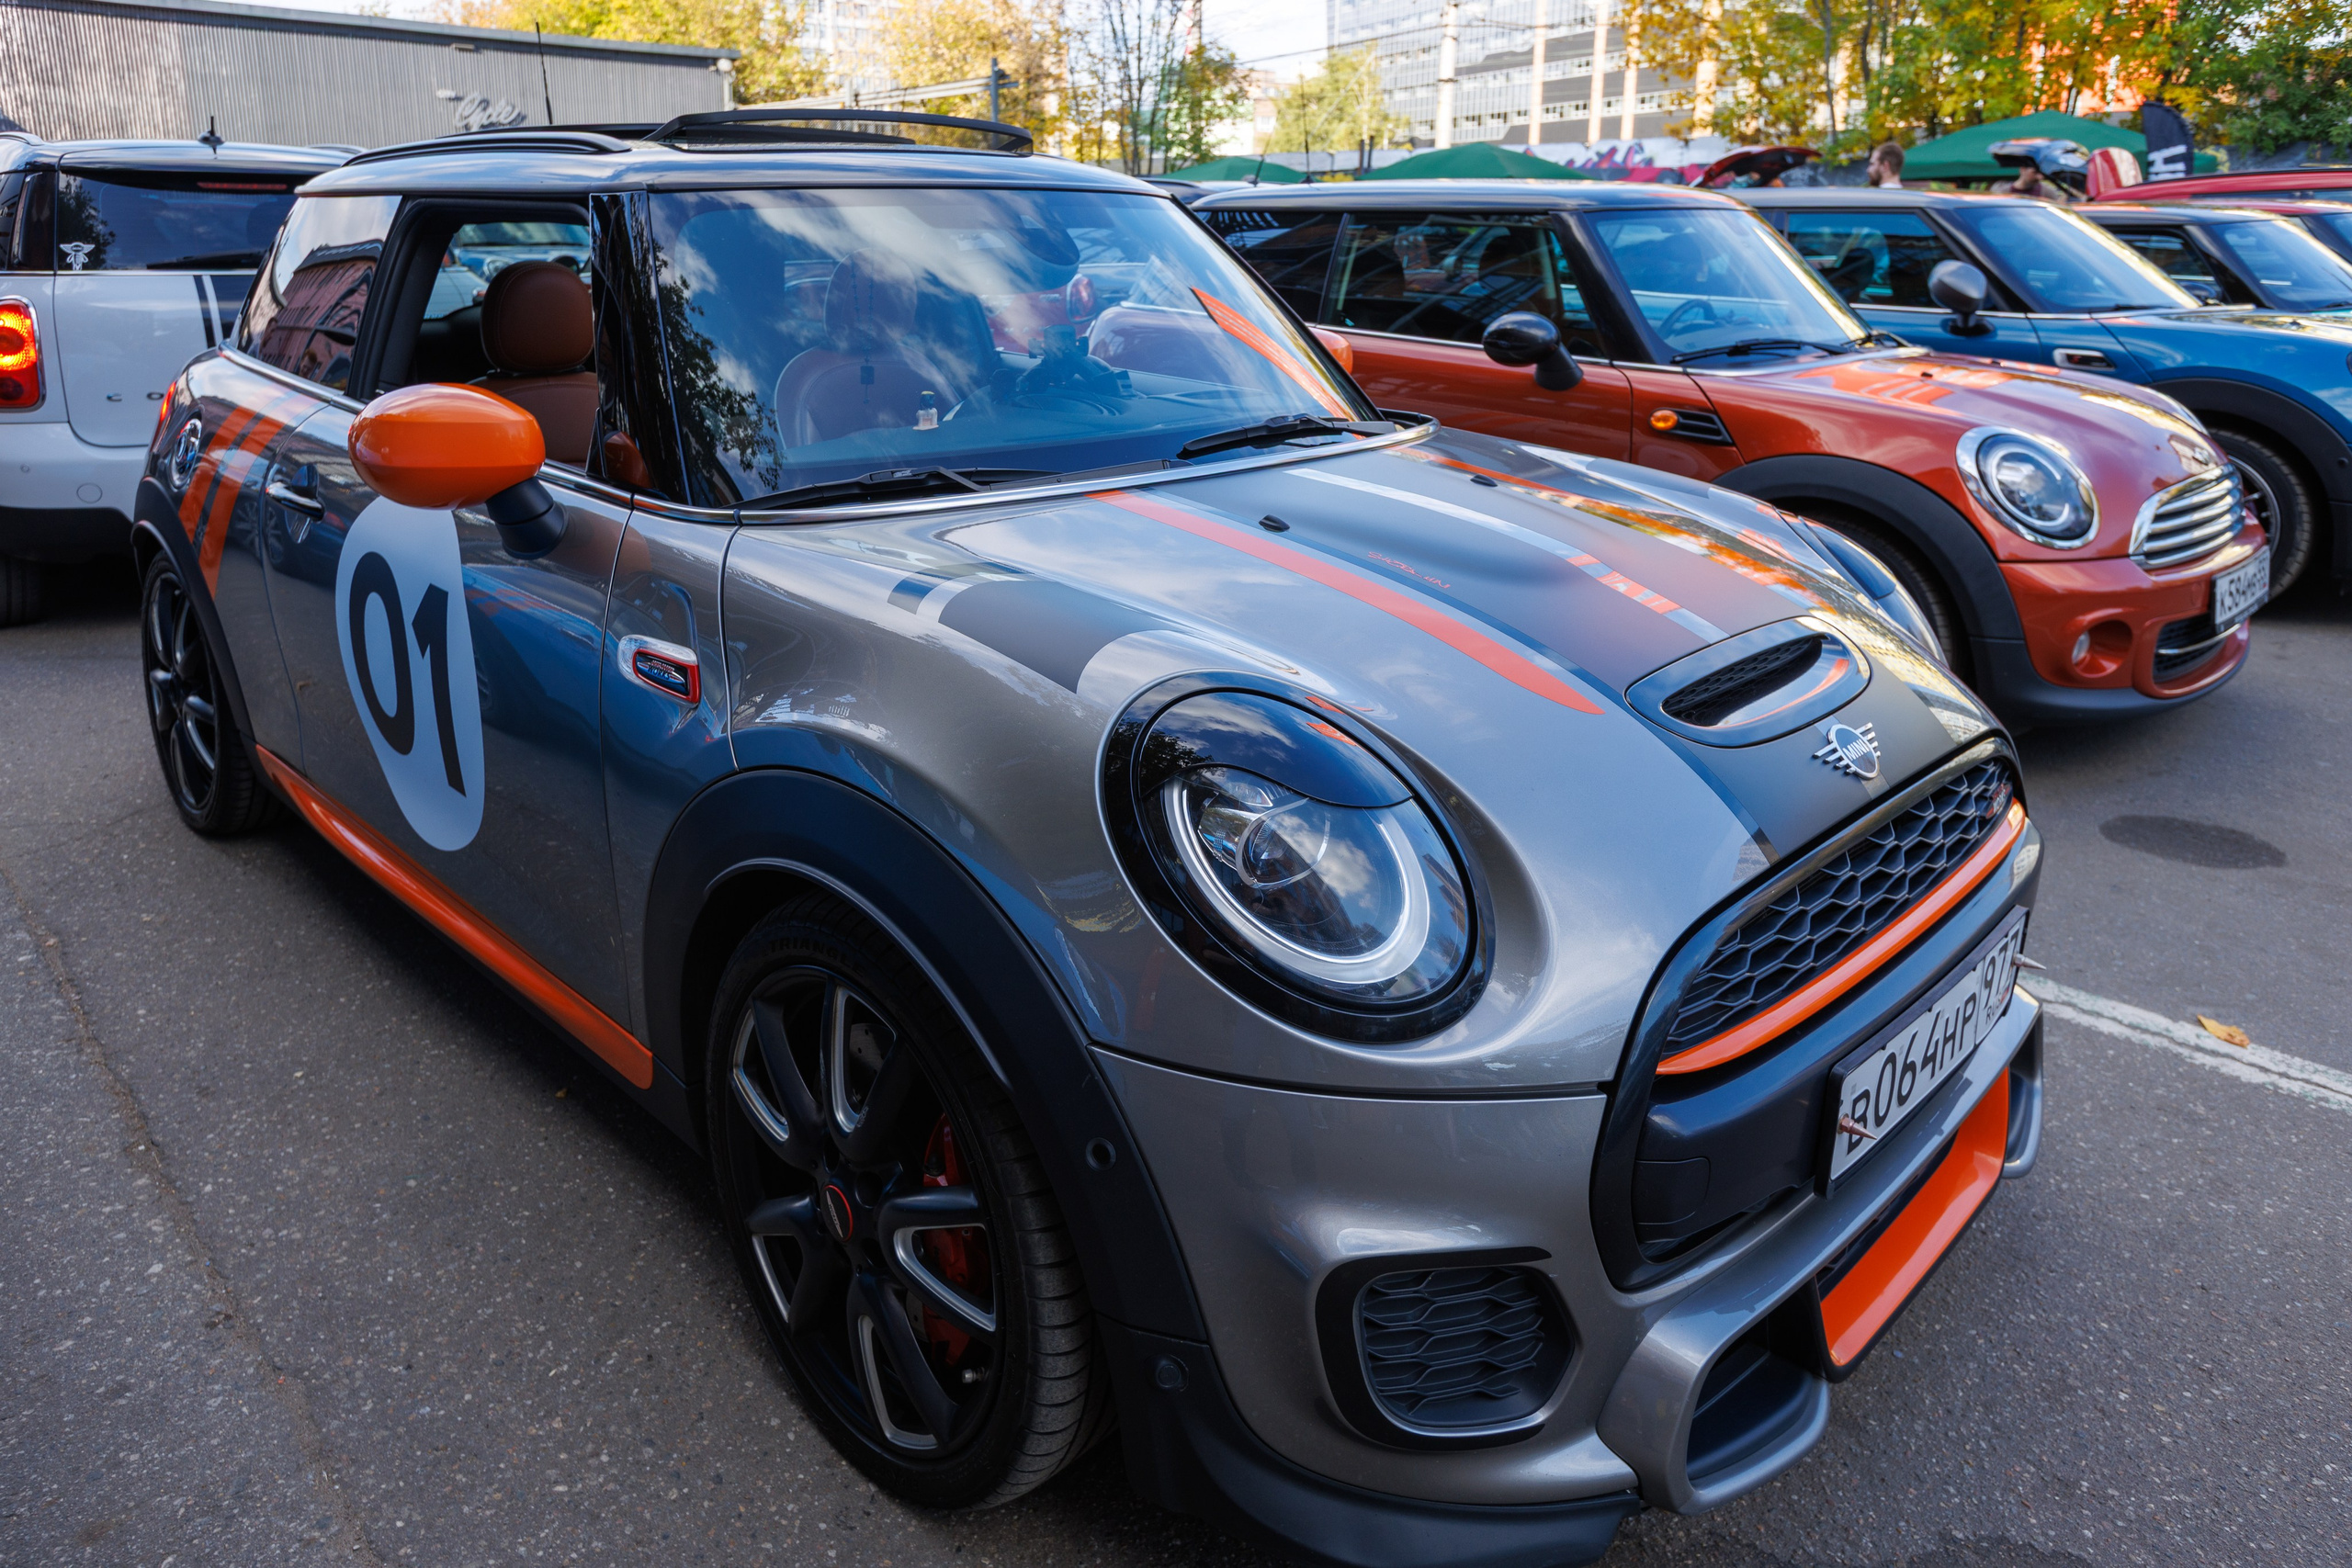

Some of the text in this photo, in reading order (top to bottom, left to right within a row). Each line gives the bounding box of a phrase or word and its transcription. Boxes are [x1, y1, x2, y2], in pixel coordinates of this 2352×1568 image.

[348, 551, 467, 797] 01
[1842, 739, 1870, 761] MINI
[769, 936, 865, 978] TRIANGLE
